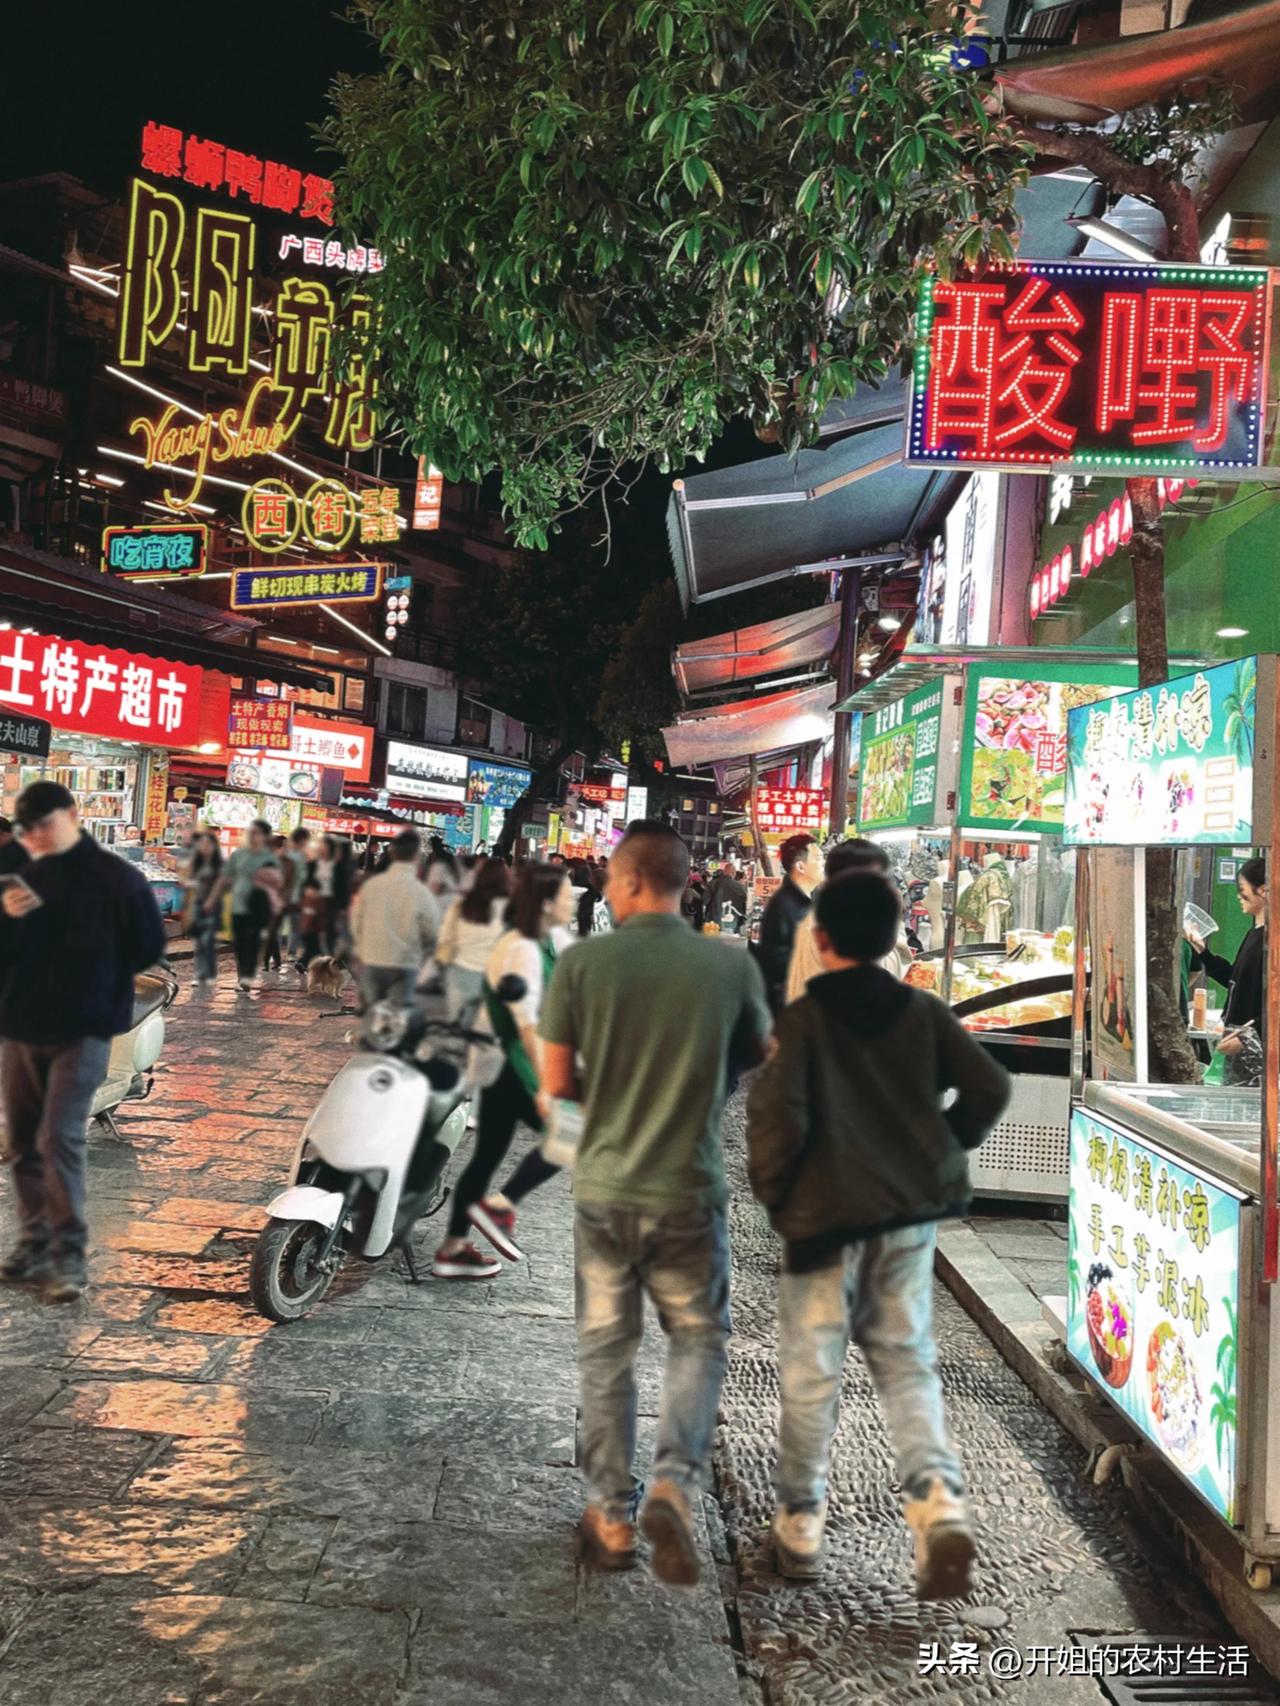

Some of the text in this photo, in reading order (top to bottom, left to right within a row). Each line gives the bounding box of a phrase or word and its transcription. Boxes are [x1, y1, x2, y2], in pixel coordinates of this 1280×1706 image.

[930, 277, 1258, 453] 酸嘢
[129, 404, 212, 510] Yang
[253, 492, 346, 538] 西街
[110, 534, 194, 569] 吃宵夜
[250, 571, 368, 599] 鲜切现串炭火烤
[0, 636, 187, 733] 土特产超市
